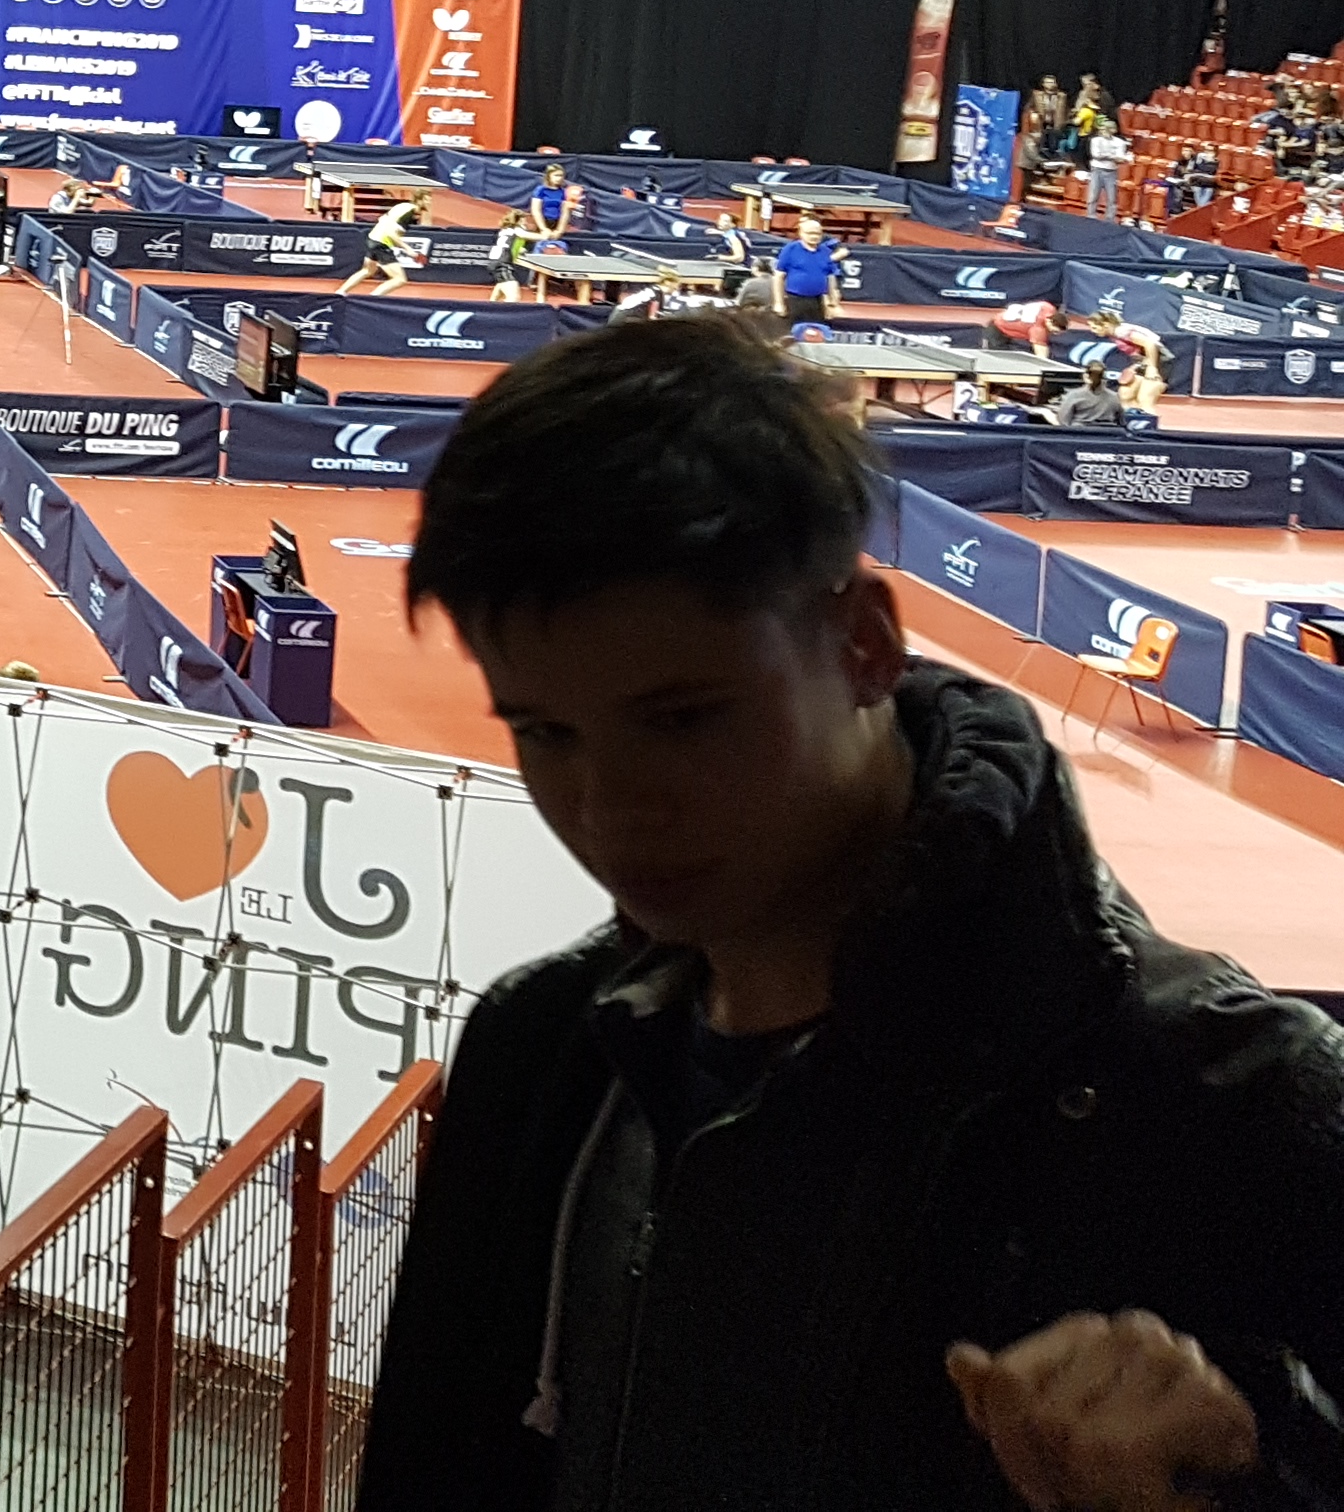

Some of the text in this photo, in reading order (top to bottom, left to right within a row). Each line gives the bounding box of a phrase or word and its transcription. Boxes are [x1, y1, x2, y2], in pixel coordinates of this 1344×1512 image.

[270, 235, 294, 251] DU
[294, 236, 334, 253] PING
[85, 411, 121, 436] DU
[123, 413, 180, 437] PING
[1072, 464, 1252, 488] CHAMPIONNATS
[1068, 481, 1194, 505] DE FRANCE
